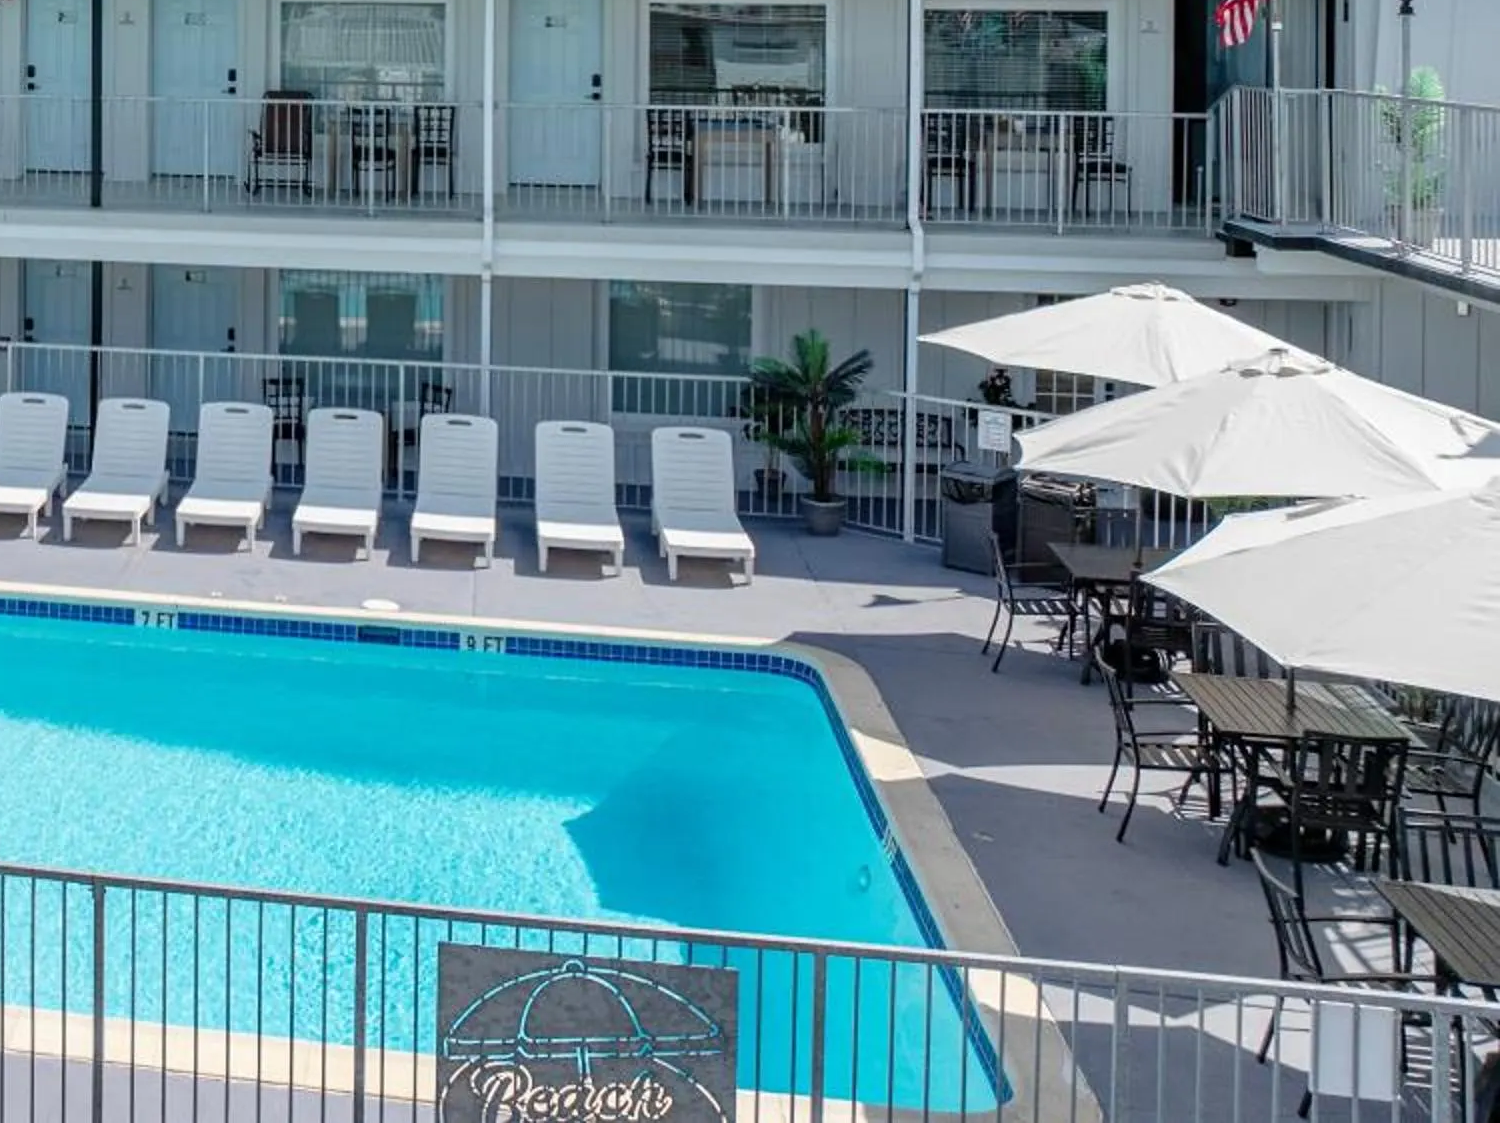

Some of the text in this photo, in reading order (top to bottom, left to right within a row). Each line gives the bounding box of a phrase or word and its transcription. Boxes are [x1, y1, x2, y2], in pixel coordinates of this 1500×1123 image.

[141, 610, 174, 629] 7 FT
[483, 636, 504, 653] FT
[470, 1060, 673, 1123] Beach
